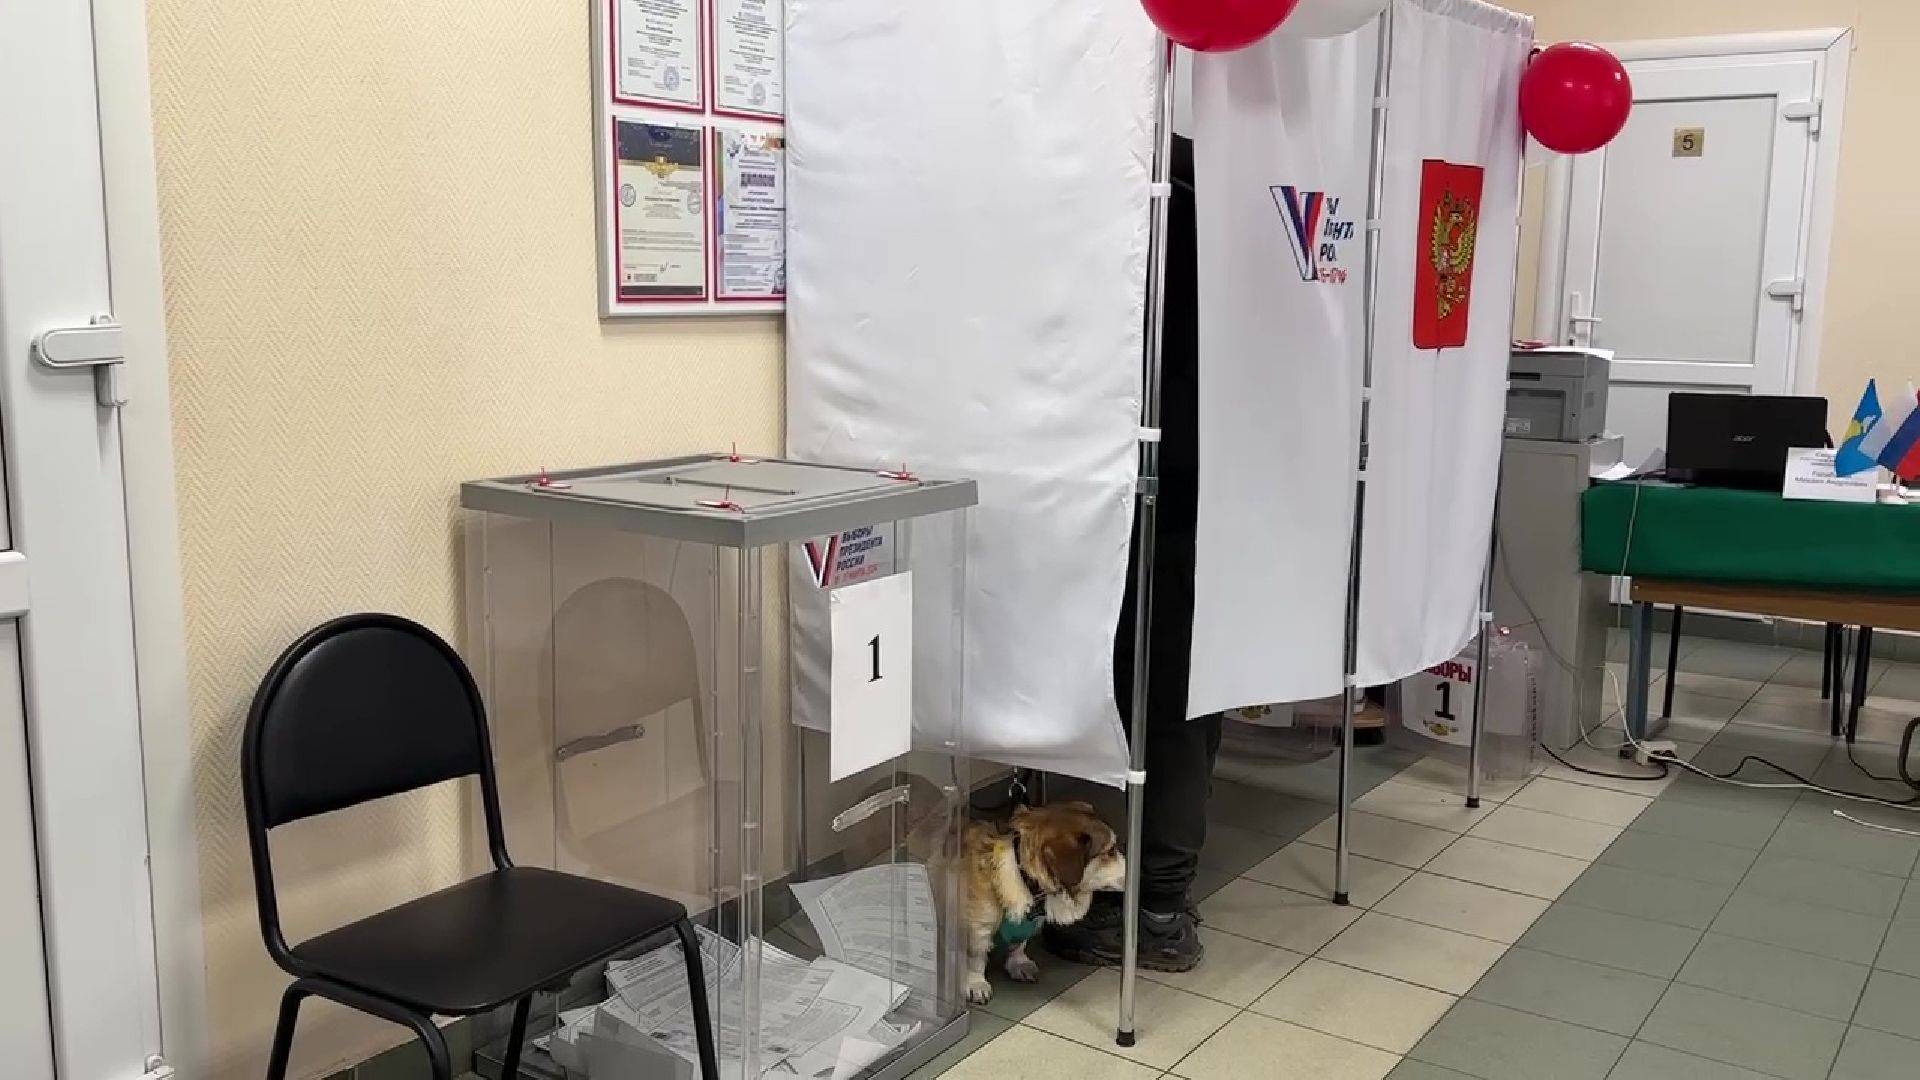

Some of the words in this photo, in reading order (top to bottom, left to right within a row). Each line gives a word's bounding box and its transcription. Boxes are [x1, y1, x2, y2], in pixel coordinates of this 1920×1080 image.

[1682, 133, 1694, 151] 5
[840, 536, 883, 556] ПРЕЗИДЕНТА
[836, 555, 865, 572] РОССИИ
[867, 633, 884, 684] 1
[1434, 681, 1456, 721] 1
